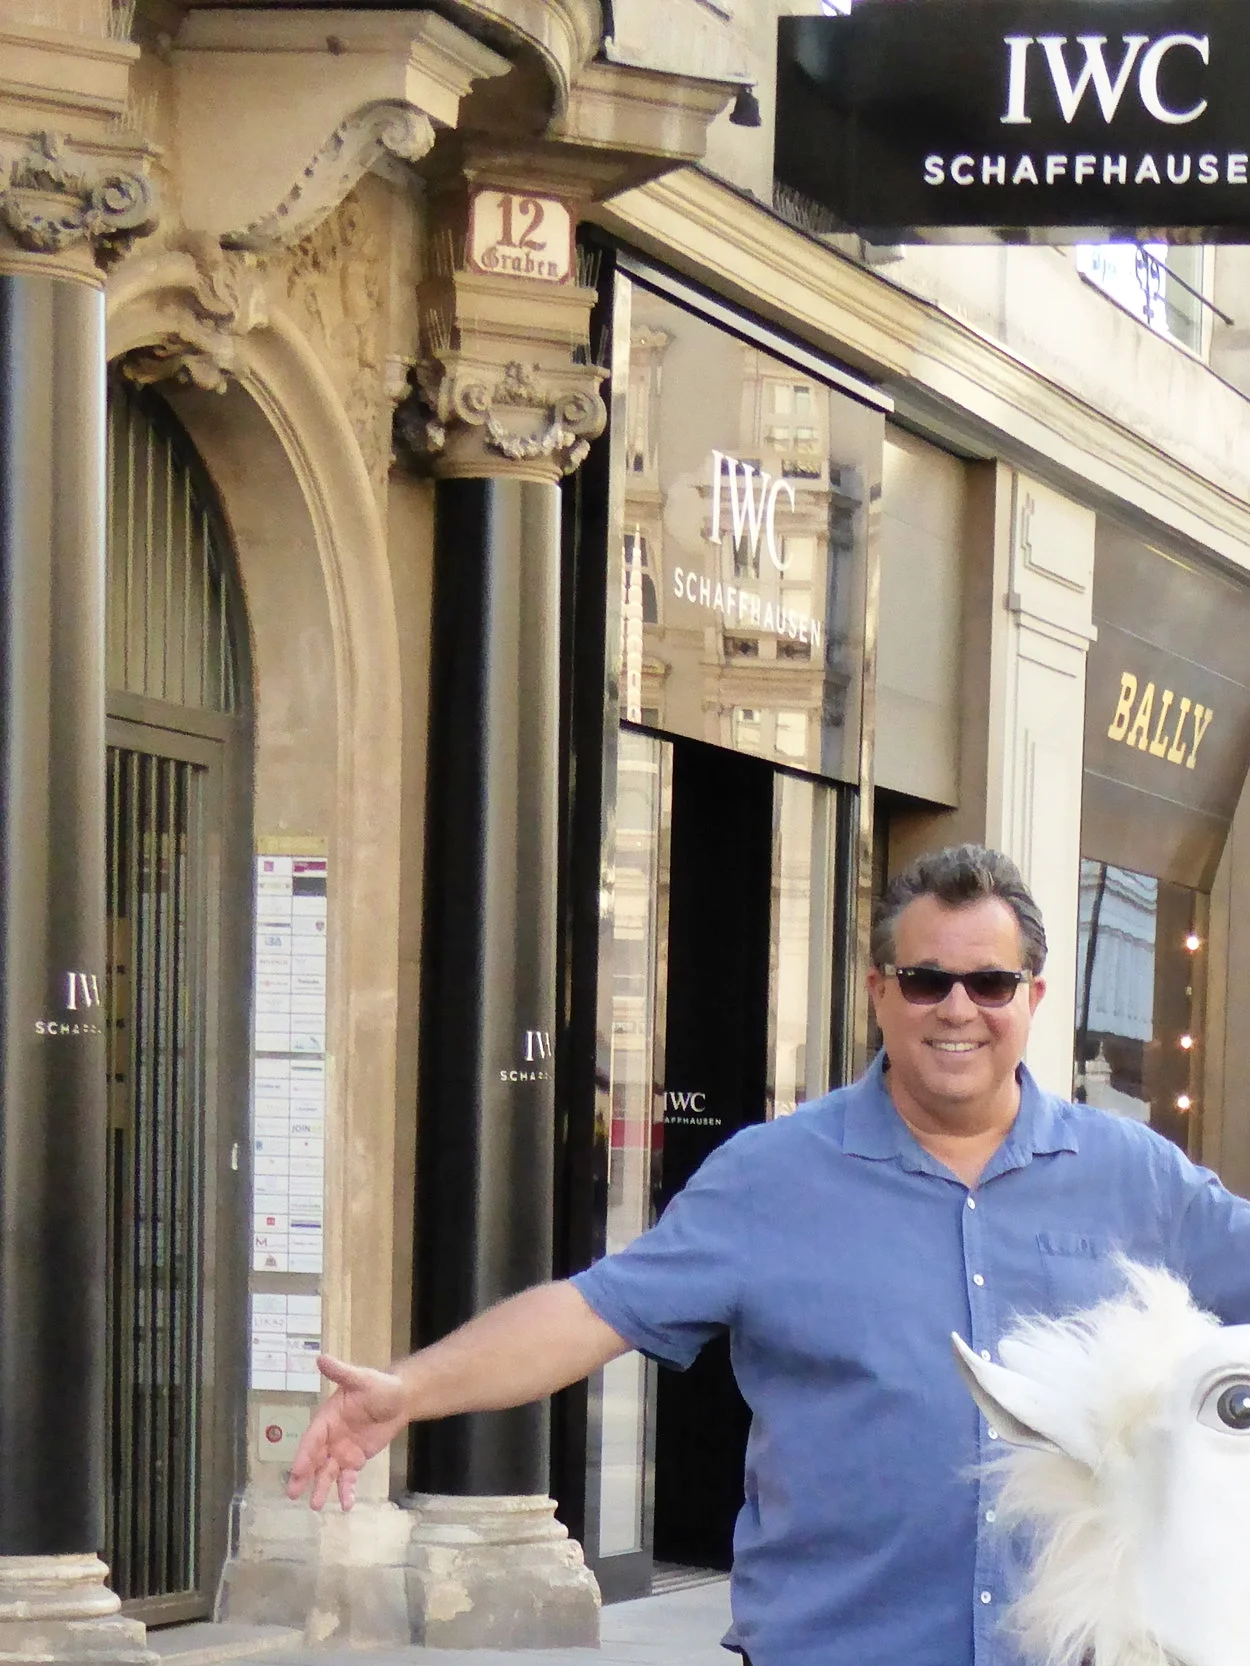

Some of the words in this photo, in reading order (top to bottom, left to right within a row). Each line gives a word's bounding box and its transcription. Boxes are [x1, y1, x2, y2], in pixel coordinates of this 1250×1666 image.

[1000, 34, 1210, 125] IWC
[496, 194, 548, 251] 12
[709, 449, 796, 571] IWC
[673, 566, 821, 647] SCHAFFHAUSEN
[1107, 671, 1214, 770] BALLY
